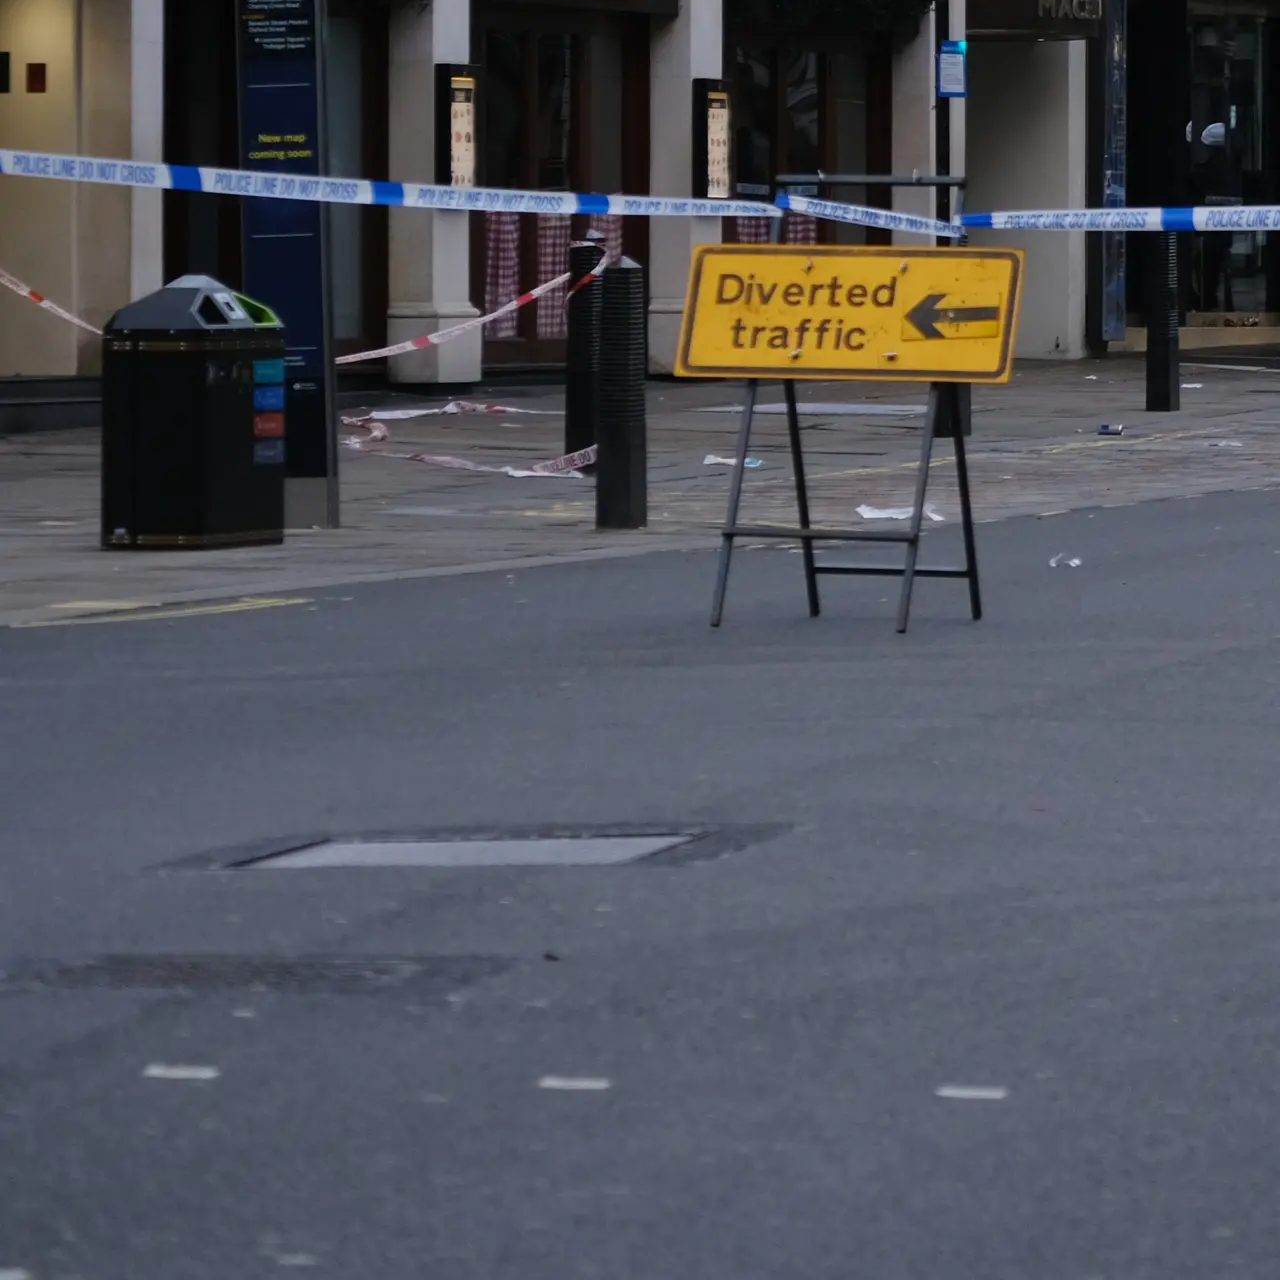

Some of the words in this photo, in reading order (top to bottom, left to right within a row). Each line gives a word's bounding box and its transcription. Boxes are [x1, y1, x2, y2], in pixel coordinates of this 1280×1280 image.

[257, 133, 281, 145] New
[1205, 209, 1242, 227] POLICE
[1246, 208, 1268, 227] LINE
[716, 273, 896, 308] Diverted
[731, 318, 866, 352] traffic
